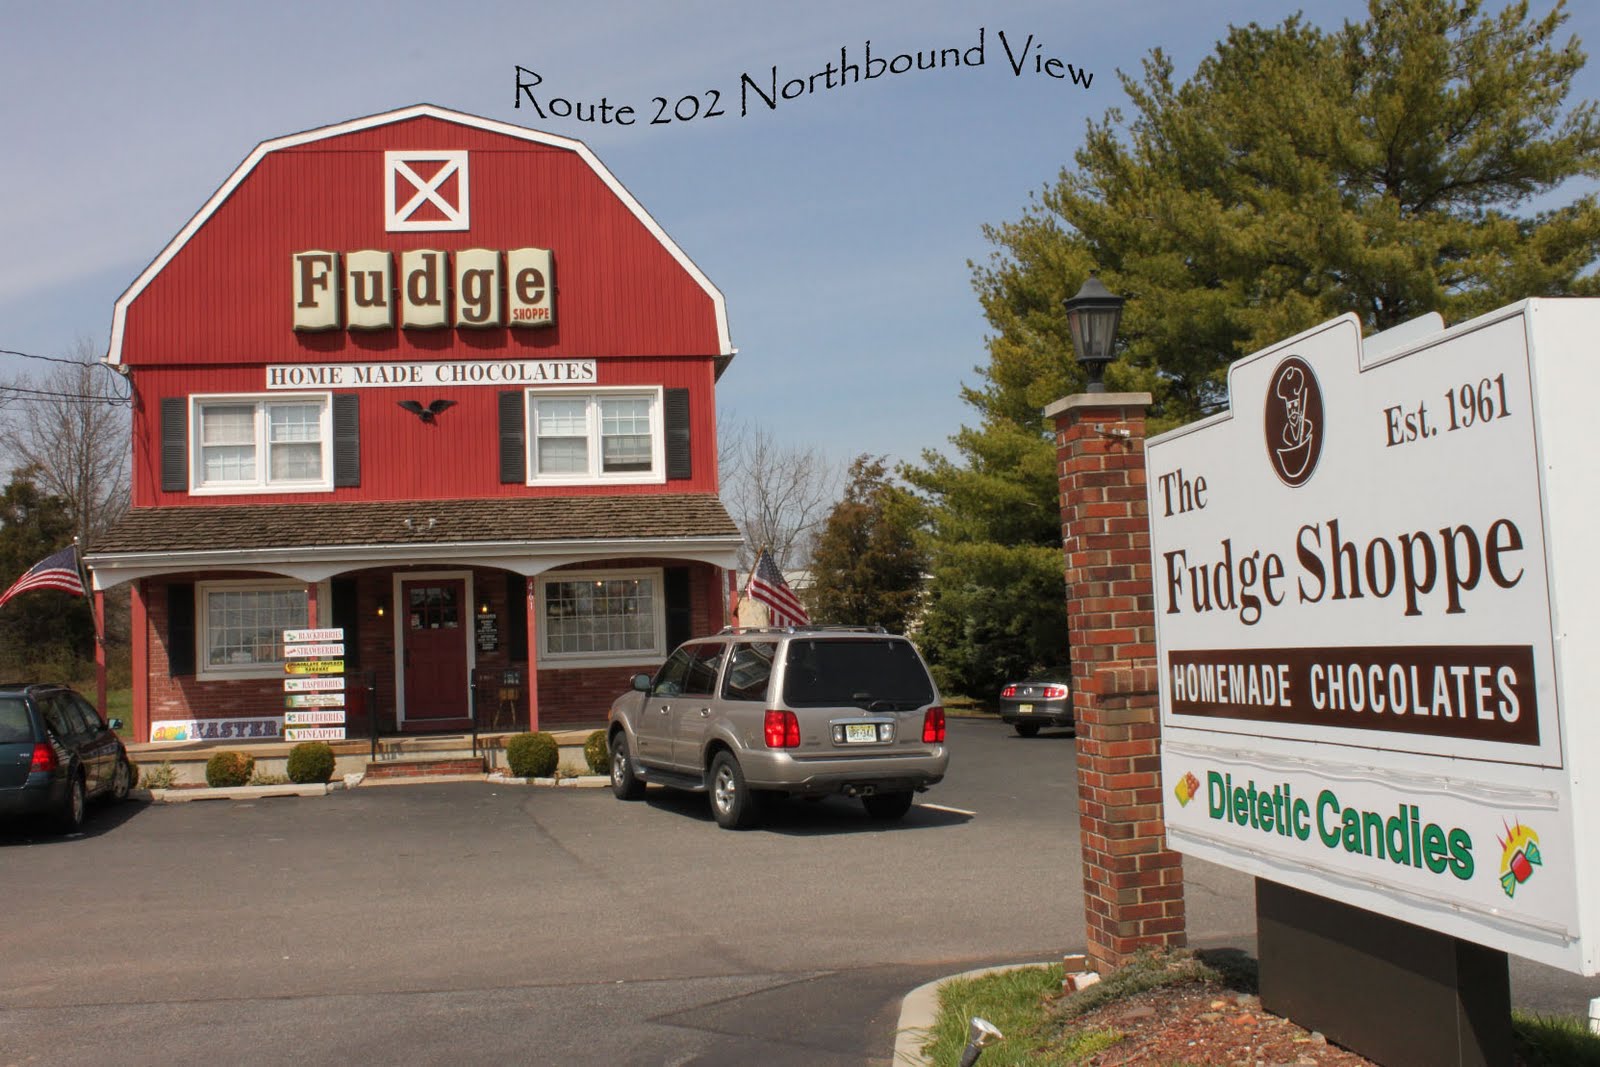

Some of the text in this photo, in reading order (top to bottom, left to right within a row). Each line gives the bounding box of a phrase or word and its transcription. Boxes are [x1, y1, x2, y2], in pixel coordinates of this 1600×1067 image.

[296, 253, 546, 323] Fudge
[513, 307, 549, 320] SHOPPE
[271, 362, 594, 386] HOME MADE CHOCOLATES
[1383, 372, 1513, 448] Est. 1961
[1158, 467, 1209, 518] The
[1163, 517, 1525, 626] Fudge Shoppe
[298, 630, 342, 640] BLACKBERRIES
[297, 646, 343, 656] STRAWBERRIES
[302, 679, 342, 689] RASPBERRIES
[1173, 662, 1521, 723] HOMEMADE CHOCOLATES
[297, 712, 344, 722] BLUEBERRIES
[191, 720, 278, 739] EASTER
[297, 729, 343, 739] PINEAPPLE
[1206, 769, 1475, 882] Dietetic Candies
